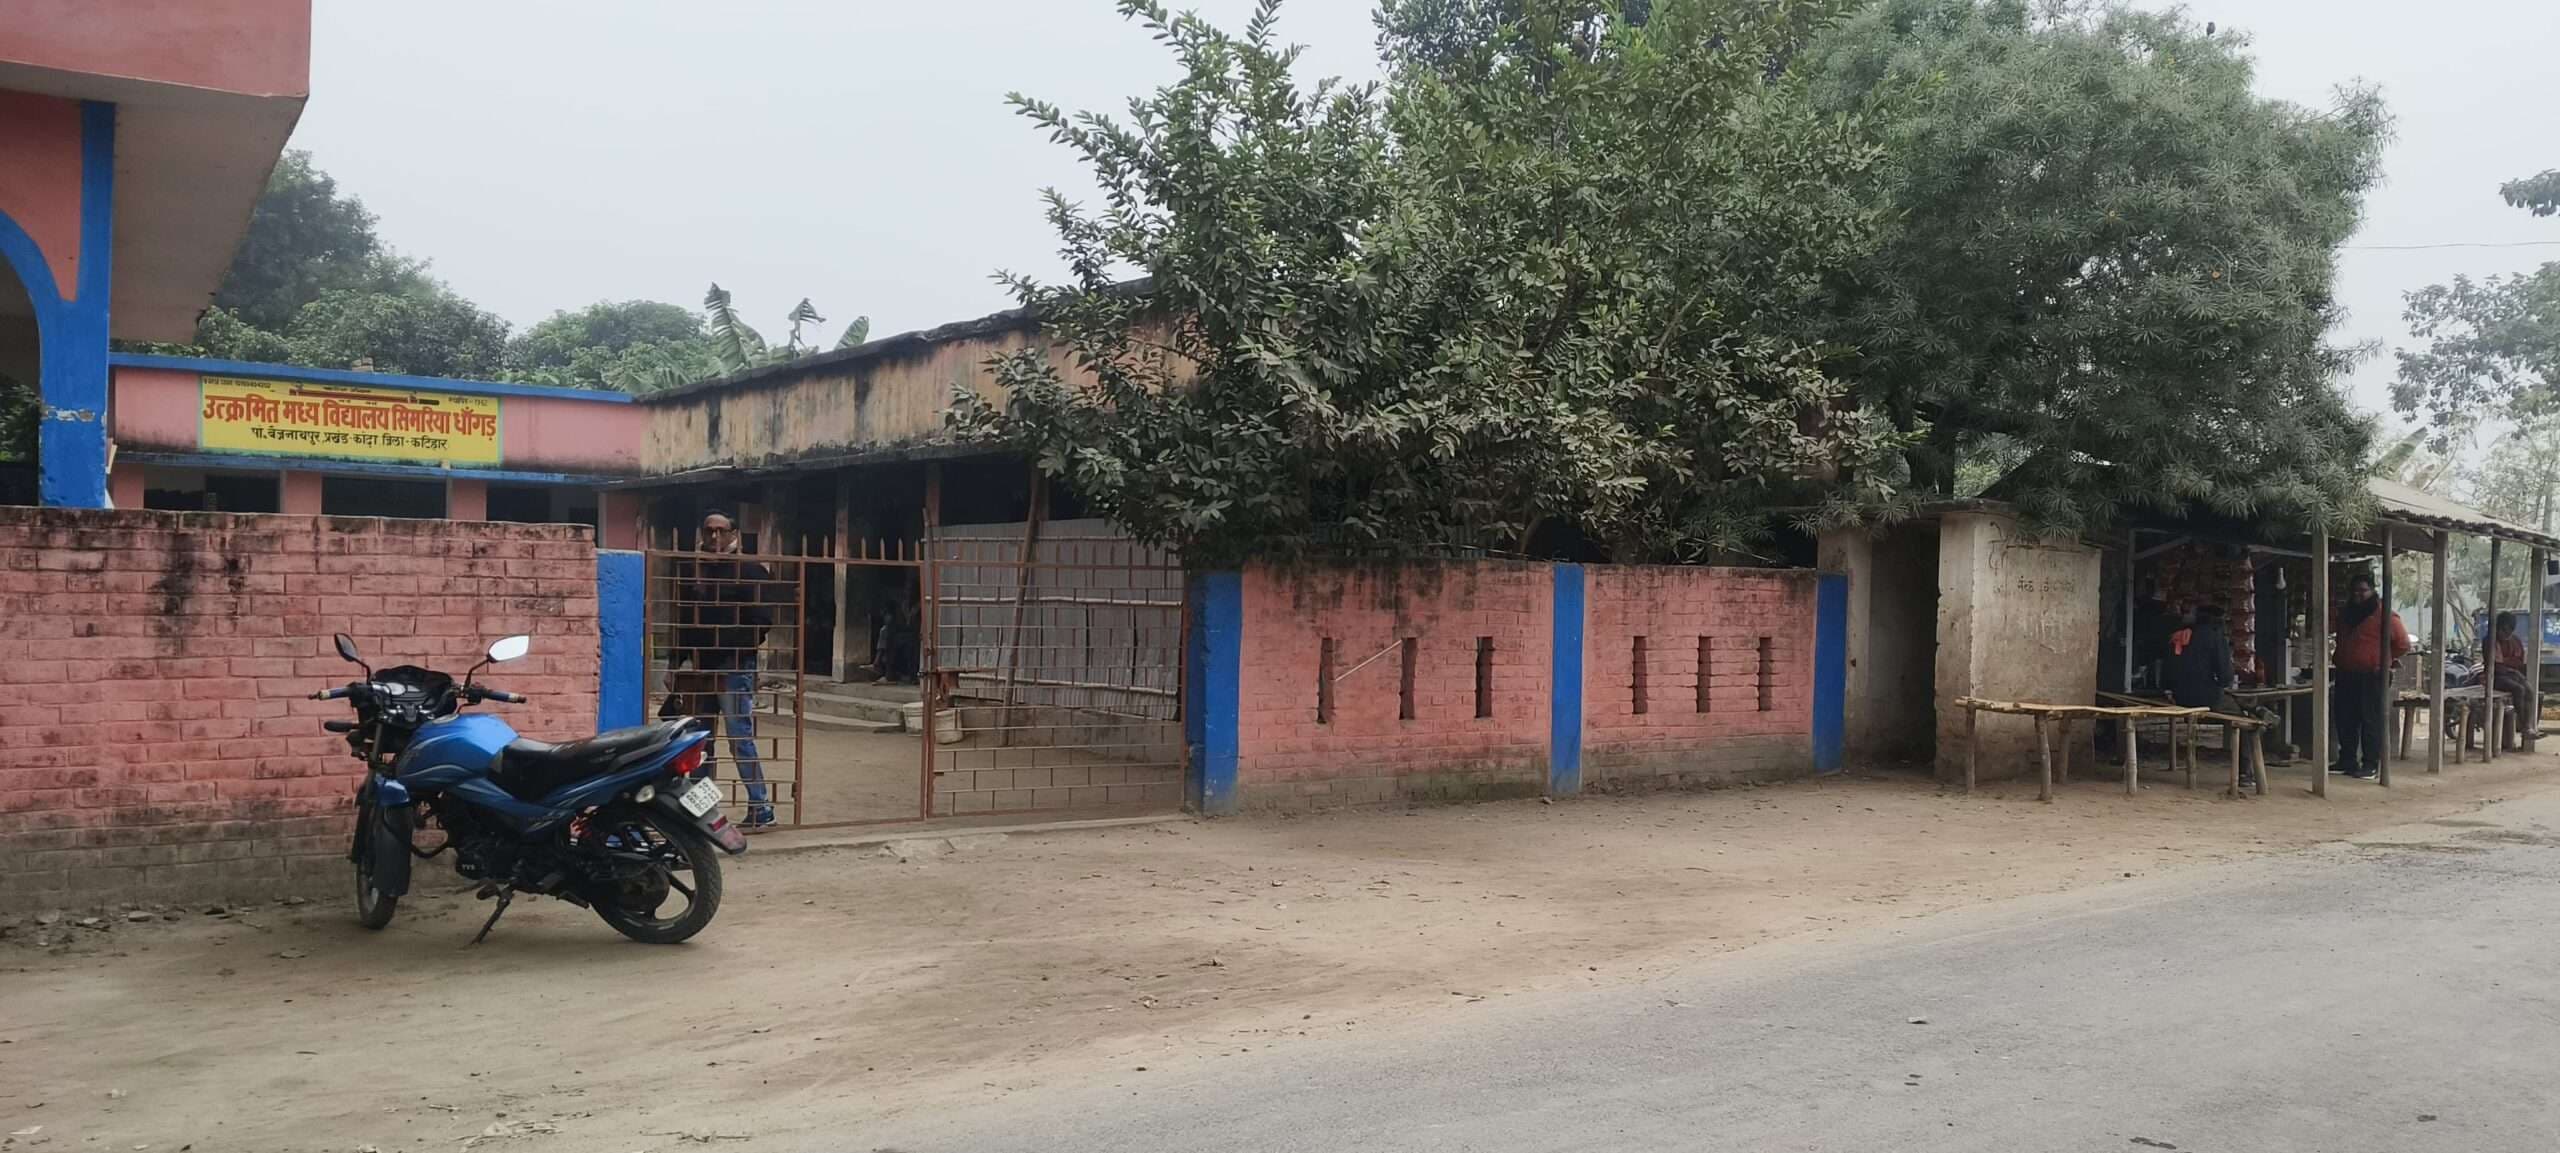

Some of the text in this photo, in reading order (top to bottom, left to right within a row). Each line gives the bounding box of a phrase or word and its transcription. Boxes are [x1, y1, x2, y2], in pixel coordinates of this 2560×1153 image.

[203, 393, 280, 423] उत्क्रमित
[282, 400, 320, 426] मध्य
[322, 399, 390, 430] विद्यालय
[391, 404, 451, 434] सिमरिया
